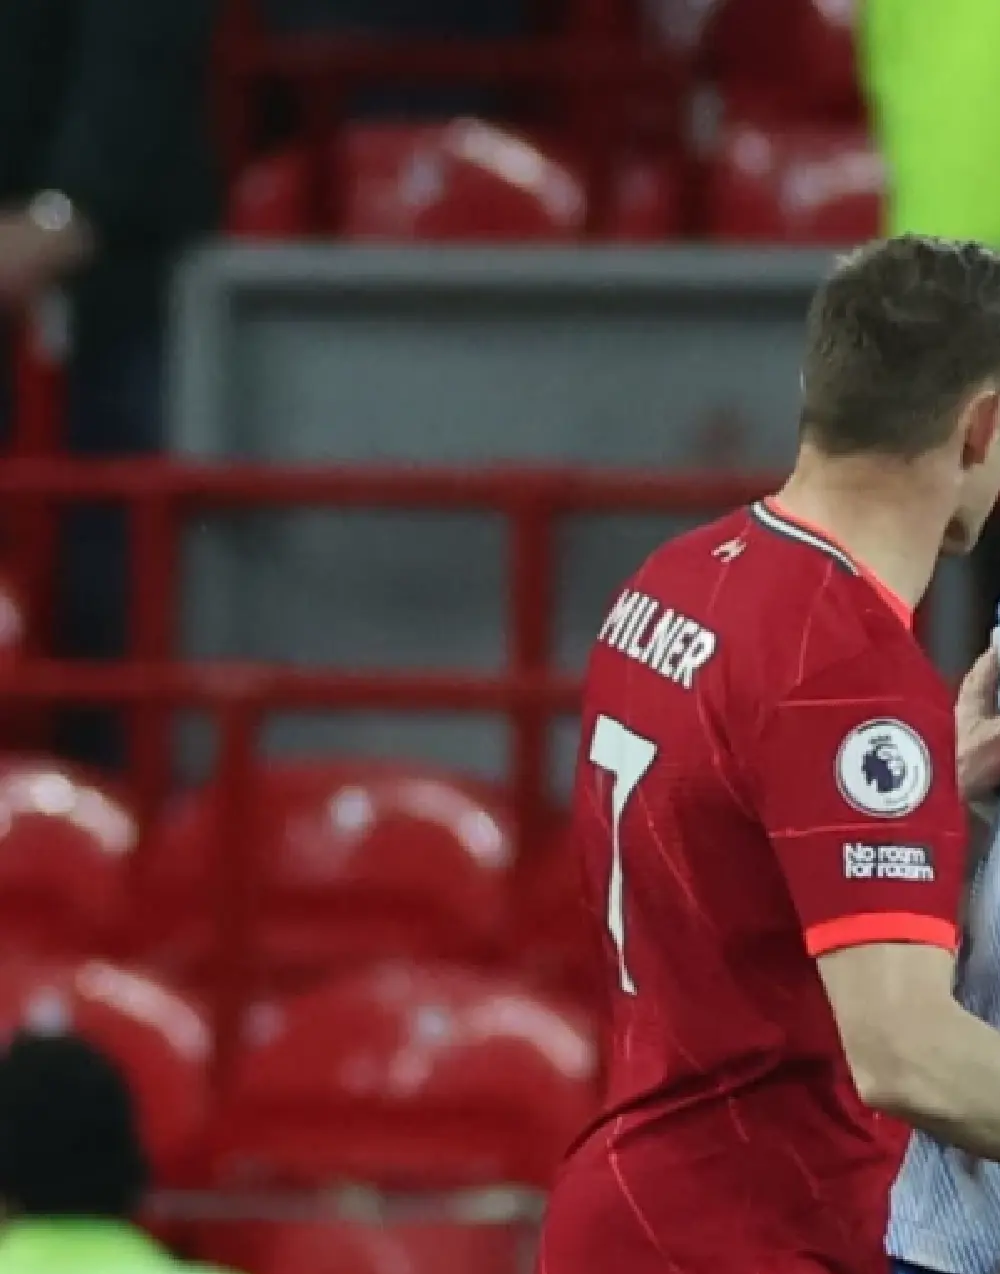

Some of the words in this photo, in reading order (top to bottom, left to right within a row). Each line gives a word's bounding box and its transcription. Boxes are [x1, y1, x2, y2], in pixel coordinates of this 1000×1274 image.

[596, 588, 716, 690] MILNER
[589, 713, 658, 996] 7
[843, 842, 876, 862] No
